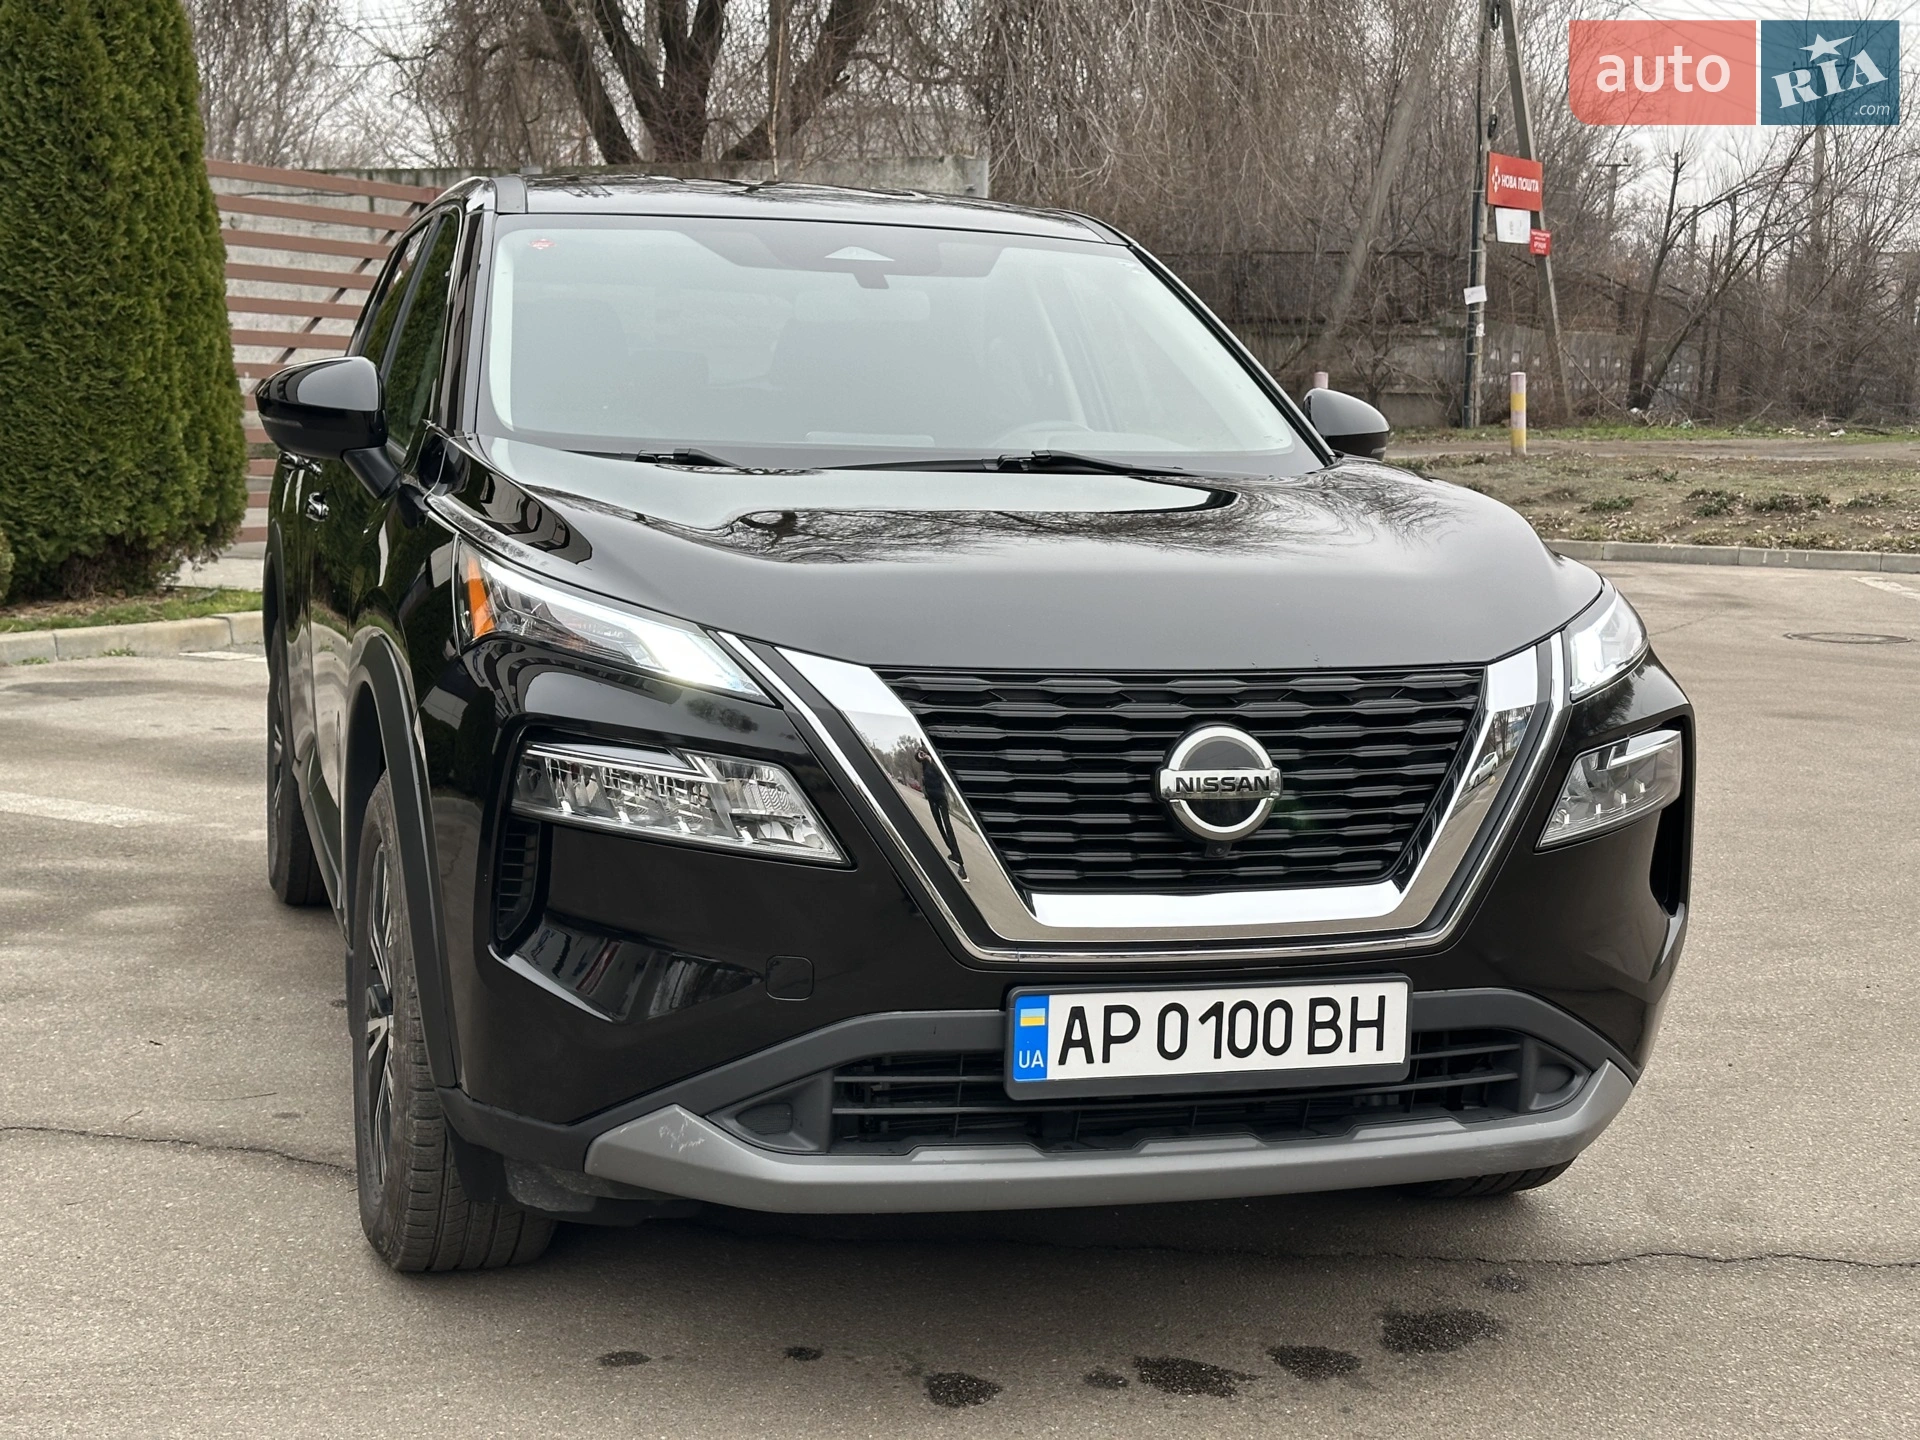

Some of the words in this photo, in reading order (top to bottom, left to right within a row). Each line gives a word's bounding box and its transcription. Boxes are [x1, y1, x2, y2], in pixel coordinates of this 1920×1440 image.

[1501, 174, 1517, 189] НОВА
[1518, 176, 1539, 193] ПОШТА
[1175, 776, 1270, 793] NISSAN
[1058, 1004, 1141, 1065] AP
[1156, 999, 1293, 1061] 0100
[1307, 995, 1386, 1055] BH
[1018, 1050, 1044, 1069] UA
